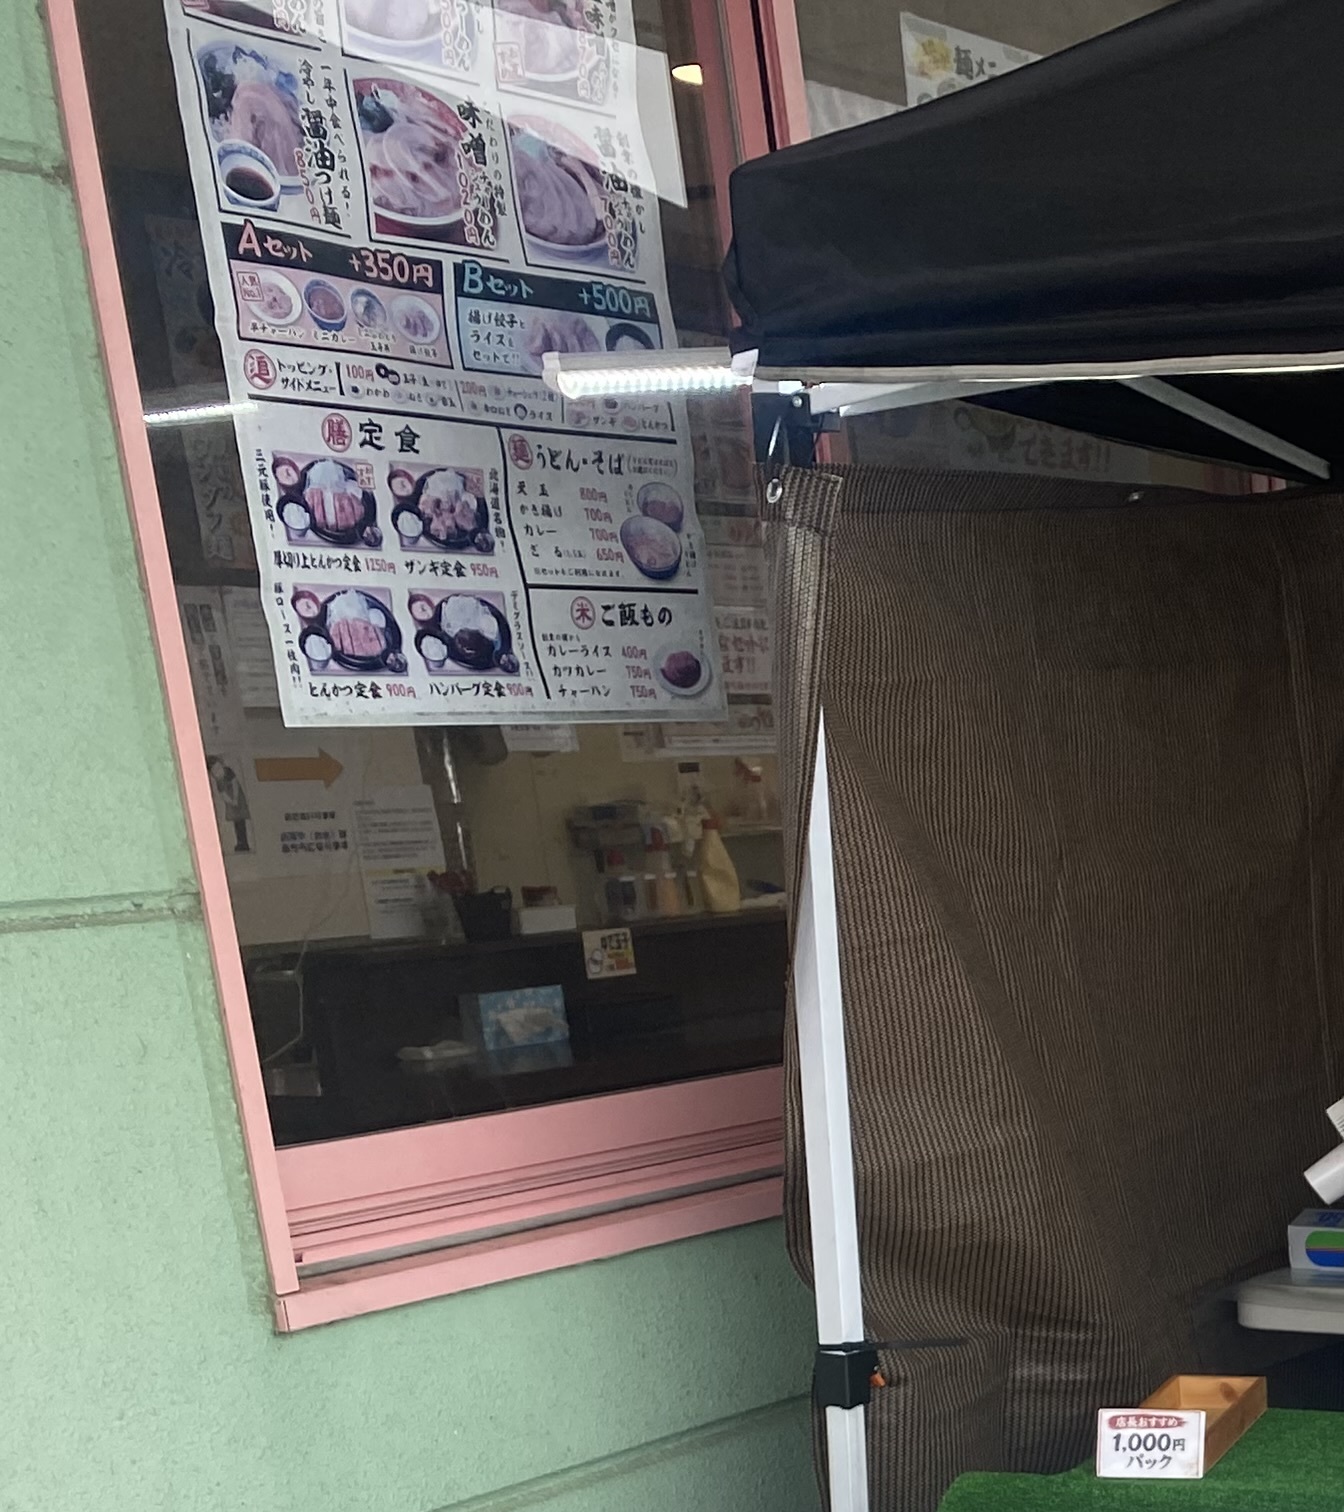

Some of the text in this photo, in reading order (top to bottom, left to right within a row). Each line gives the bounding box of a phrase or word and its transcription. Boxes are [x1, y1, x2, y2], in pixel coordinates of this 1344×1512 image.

[238, 220, 433, 287] Aセット +350円
[463, 262, 650, 317] Bセット +500円
[358, 418, 422, 455] 定食
[523, 524, 558, 537] カレー
[601, 603, 673, 628] ご飯もの
[547, 644, 613, 658] カレーライス
[308, 680, 383, 698] とんかつ定食
[1114, 1414, 1180, 1429] 店長おすすめ
[1112, 1433, 1186, 1453] 1,000円
[1126, 1454, 1173, 1469] パック
